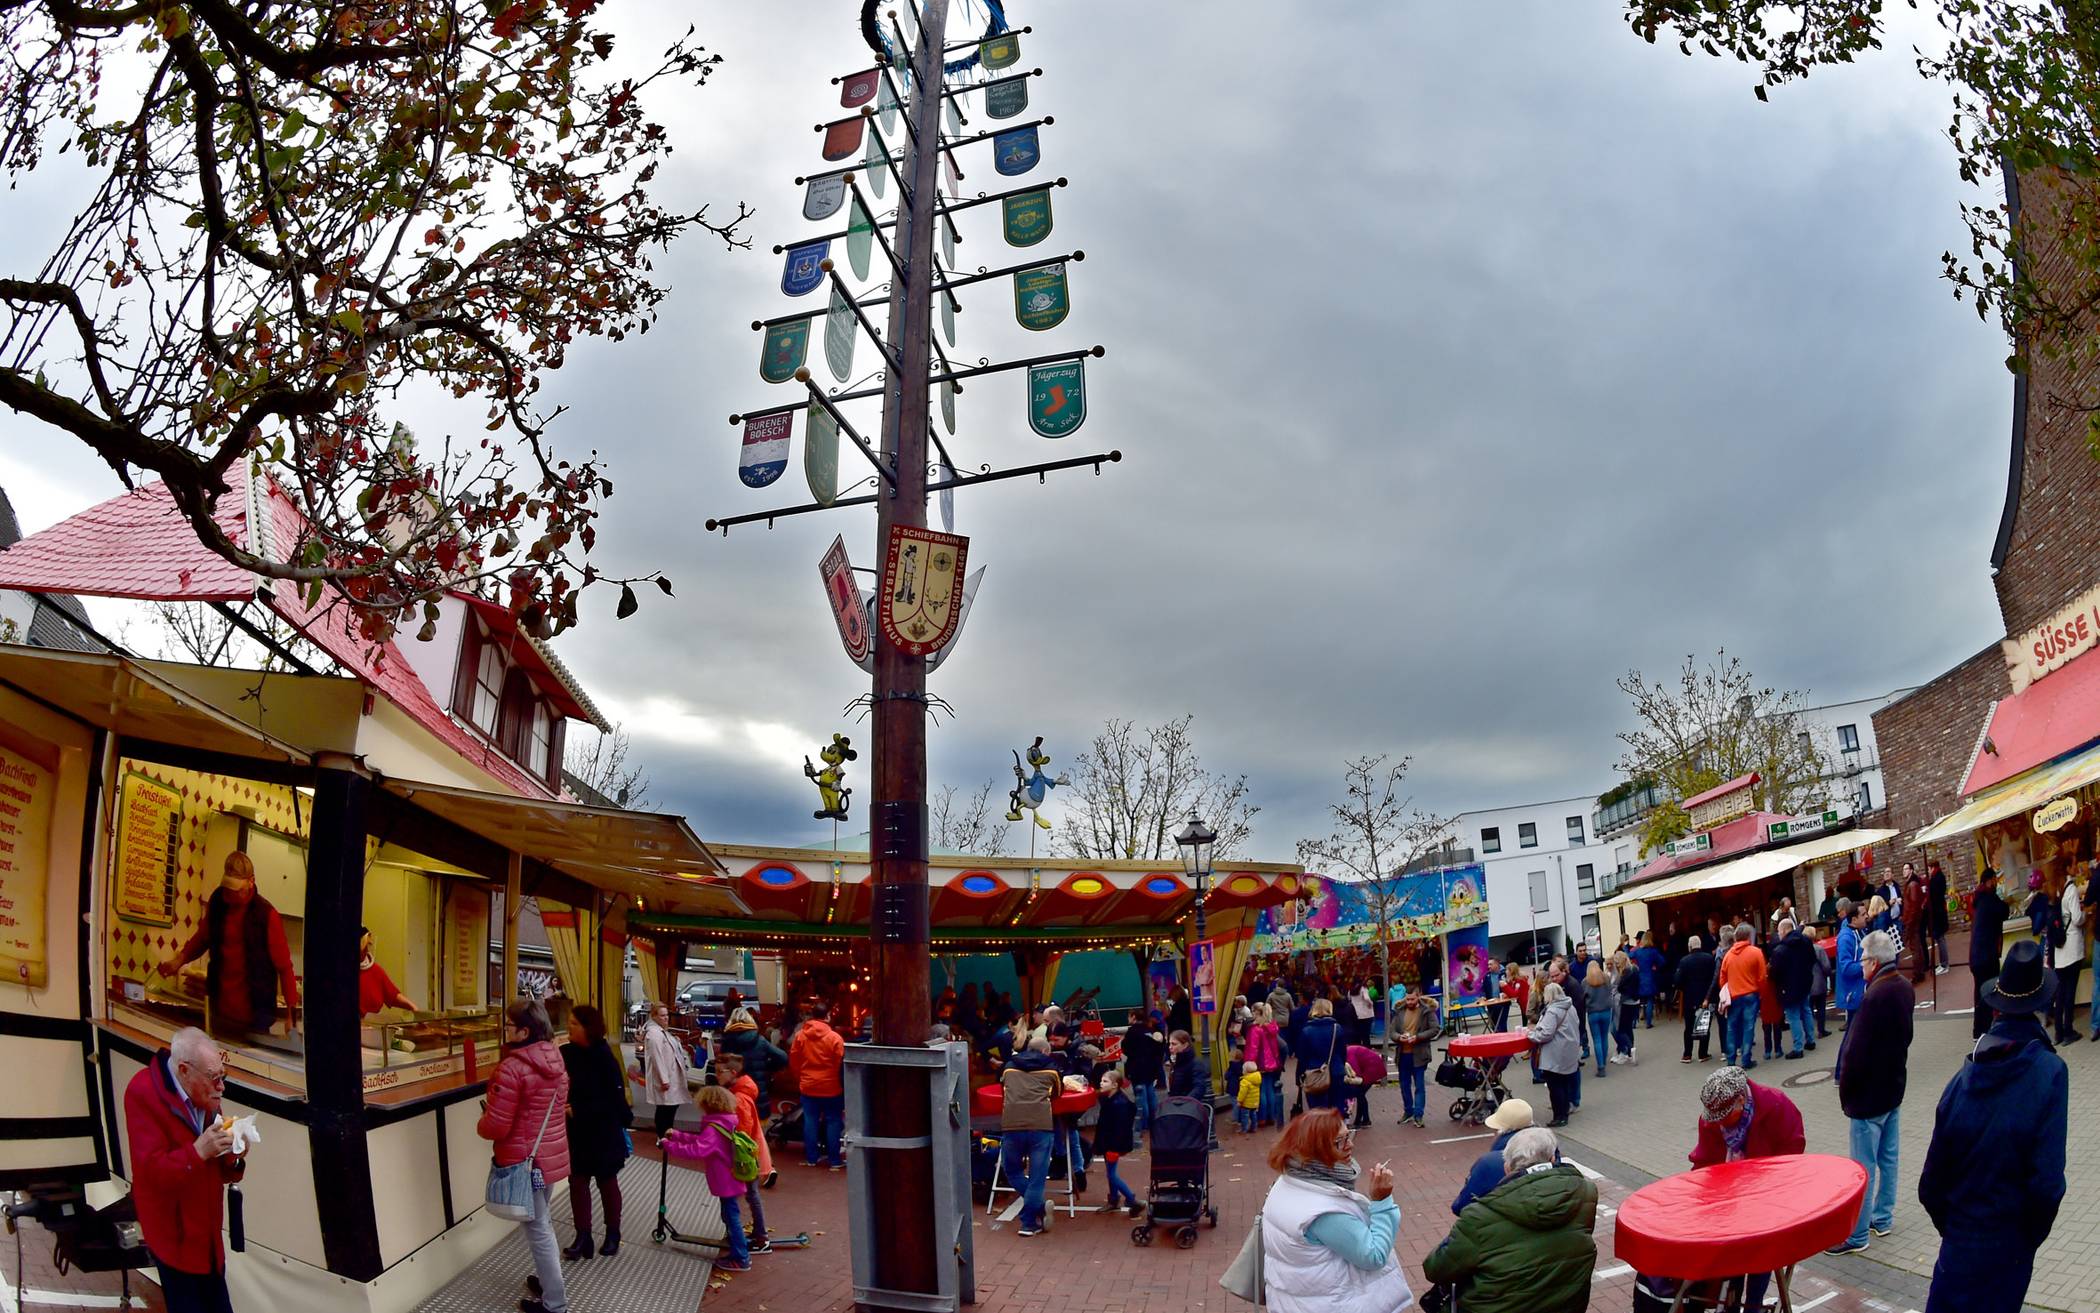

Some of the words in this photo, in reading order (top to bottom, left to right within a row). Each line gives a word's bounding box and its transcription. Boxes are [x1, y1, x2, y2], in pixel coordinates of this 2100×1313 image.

[1034, 368, 1078, 382] Jägerzug
[1034, 392, 1046, 402] 19
[750, 426, 784, 439] BOESCH
[902, 528, 959, 545] SCHIEFBAHN
[930, 577, 962, 650] BRUDERSCHAFT
[2033, 613, 2089, 667] SÜSSE
[2037, 805, 2074, 828] Zuckerwatte
[1790, 819, 1822, 832] RÖMGENS
